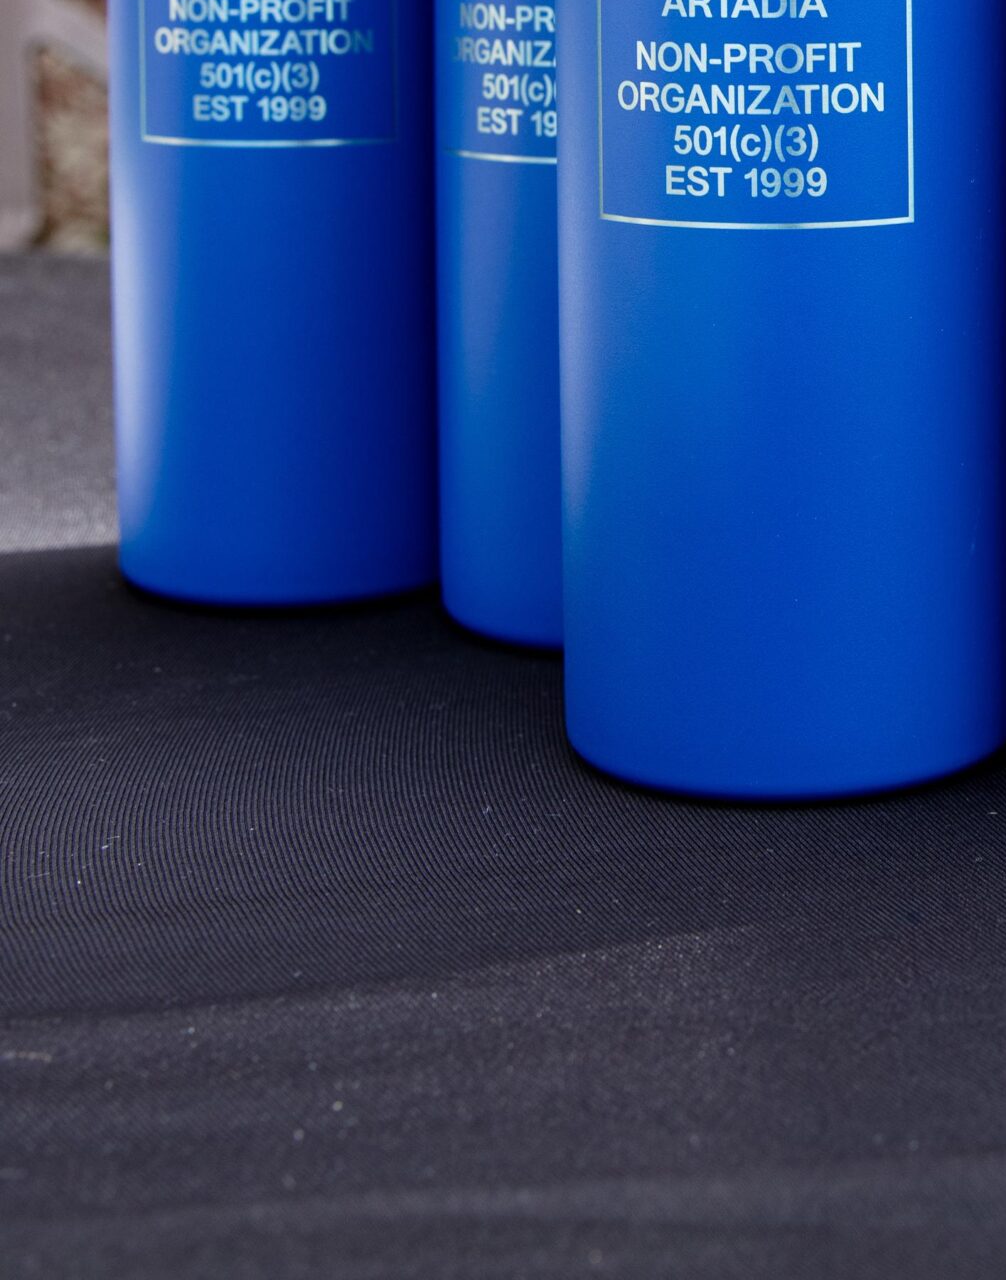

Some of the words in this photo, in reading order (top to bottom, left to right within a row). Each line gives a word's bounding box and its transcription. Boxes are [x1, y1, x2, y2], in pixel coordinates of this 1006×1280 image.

[459, 2, 555, 33] NON-PR
[154, 28, 374, 56] ORGANIZATION
[453, 36, 556, 68] RGANIZ
[636, 40, 862, 74] NON-PROFIT
[200, 62, 319, 94] 501(c)(3)
[482, 72, 556, 107] 501(c)
[193, 95, 248, 122] EST
[257, 95, 327, 122] 1999
[617, 80, 884, 115] ORGANIZATION
[476, 106, 524, 136] EST
[673, 124, 819, 163] 501(c)(3)
[665, 165, 733, 197] EST
[744, 167, 828, 198] 1999
